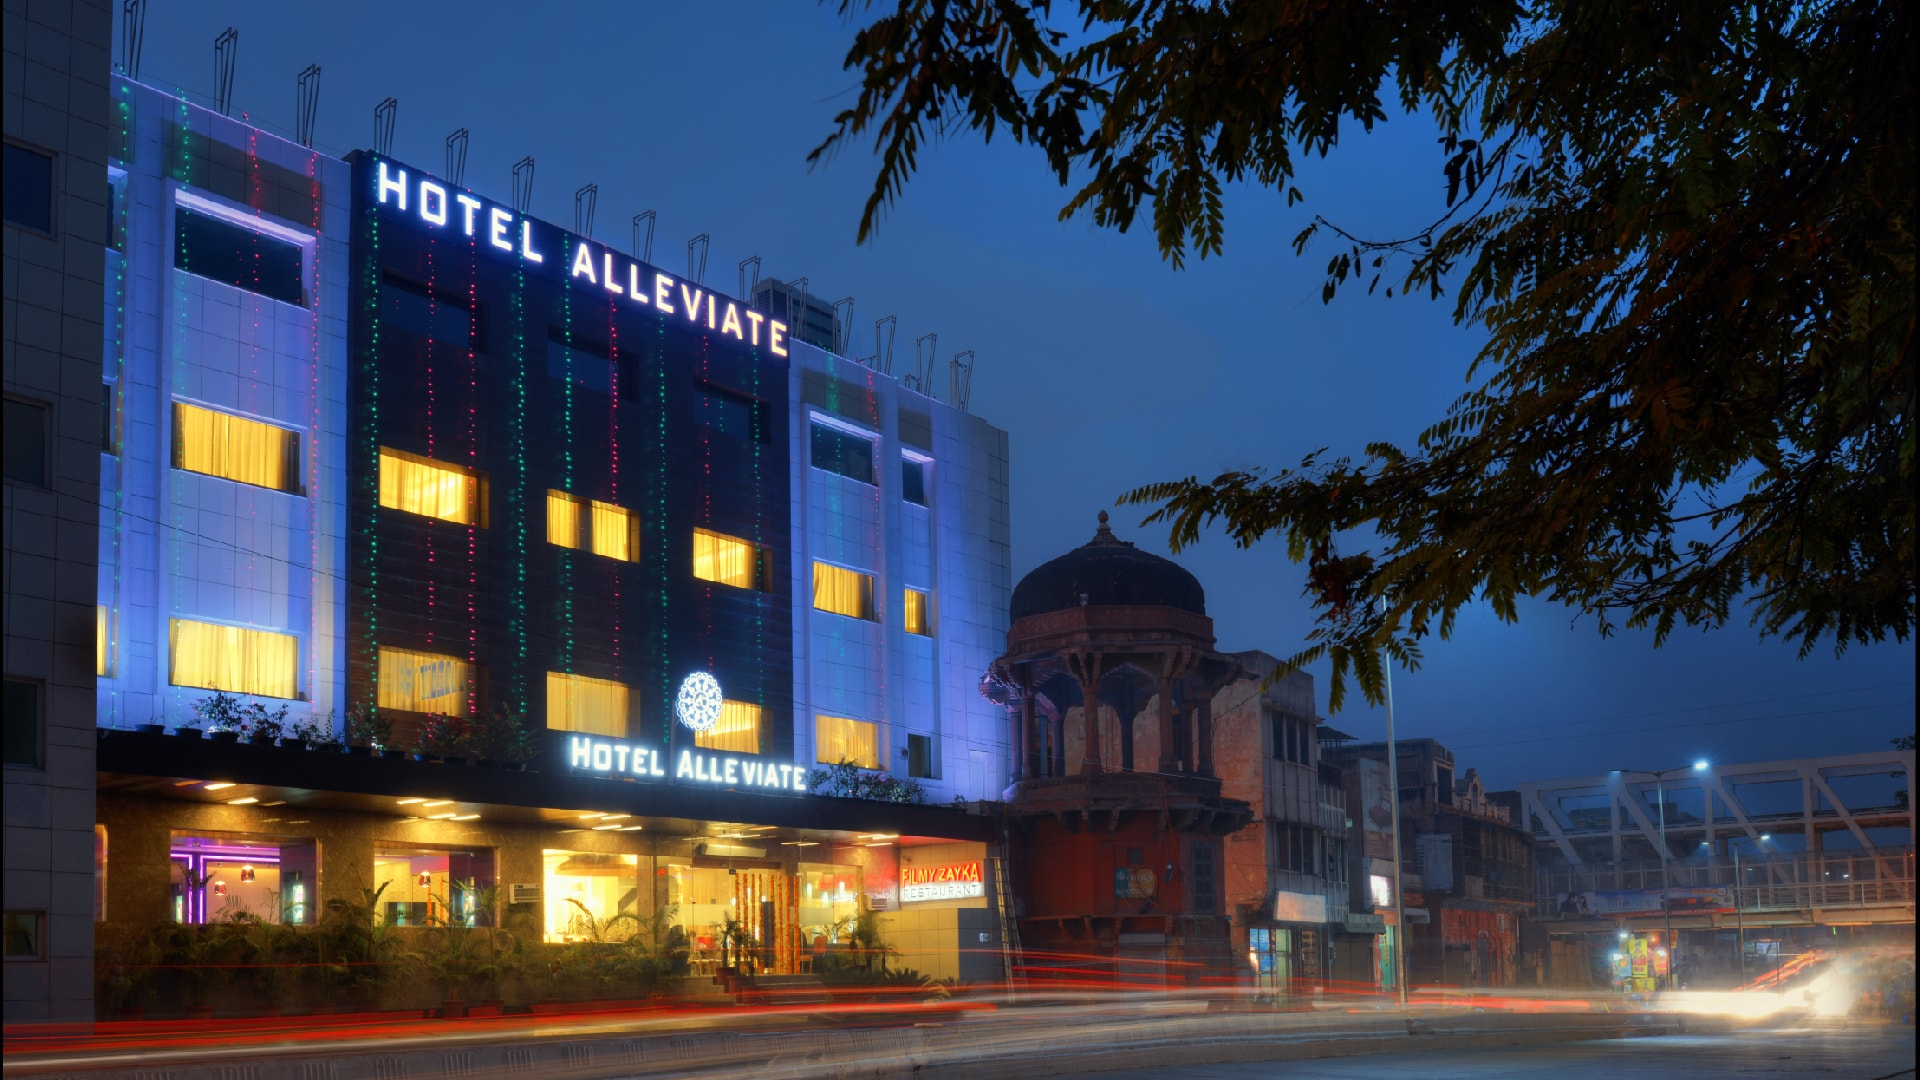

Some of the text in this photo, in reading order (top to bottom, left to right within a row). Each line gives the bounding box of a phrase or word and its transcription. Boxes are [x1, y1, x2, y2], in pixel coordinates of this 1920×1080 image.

[378, 162, 789, 357] HOTEL ALLEVIATE
[572, 737, 807, 791] HOTEL ALLEVIATE
[901, 862, 981, 888] FILMY ZAYKA
[903, 885, 978, 899] RESTAURANT
